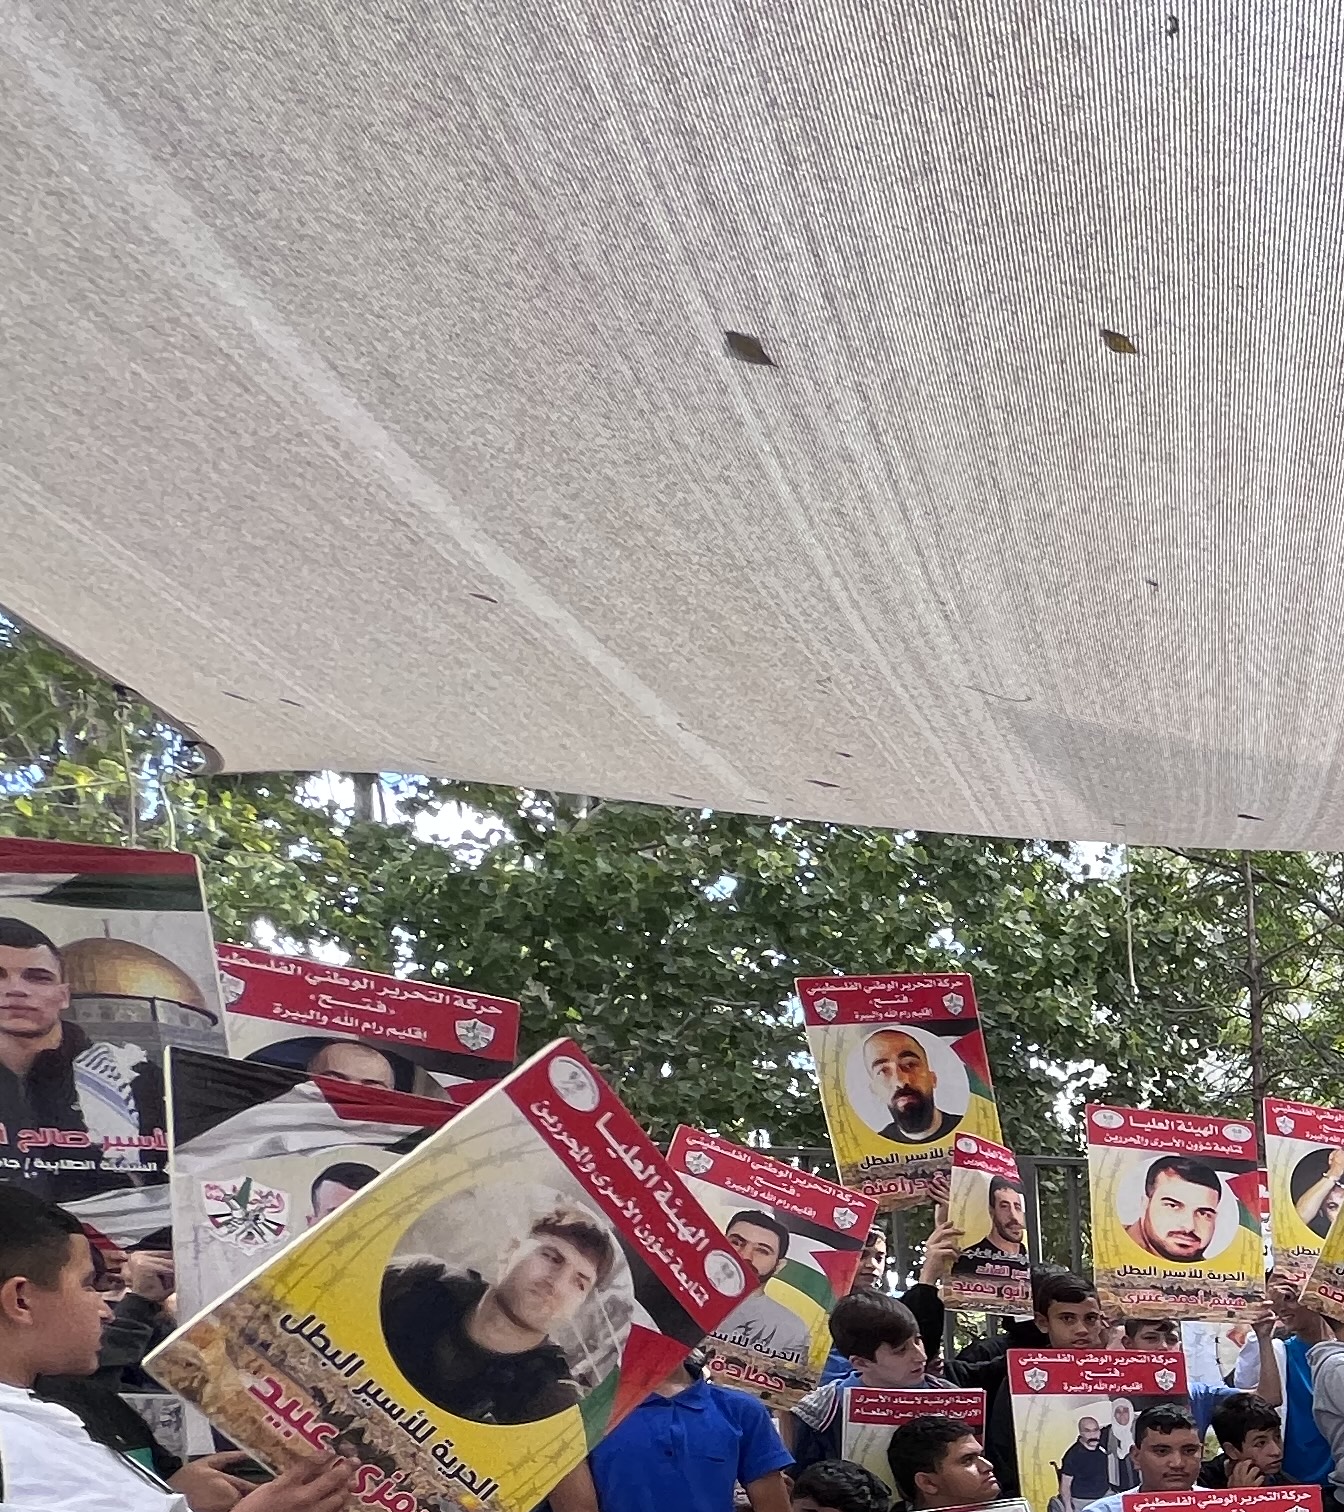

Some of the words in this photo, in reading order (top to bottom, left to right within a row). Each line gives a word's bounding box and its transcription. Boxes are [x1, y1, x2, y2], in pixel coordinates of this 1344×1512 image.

[305, 970, 375, 991] الوطني
[377, 984, 450, 1005] التحرير
[454, 996, 502, 1014] حركة
[1129, 1116, 1174, 1131] العليا
[1176, 1121, 1218, 1135] الهيئة
[595, 1111, 661, 1188] العليا
[653, 1180, 709, 1251] الهيئة
[1117, 1265, 1156, 1277] البطل
[279, 1314, 366, 1378] البطل
[1018, 1354, 1075, 1366] الفلسطيني
[1076, 1355, 1112, 1366] الوطني
[1114, 1355, 1150, 1366] التحرير
[1150, 1354, 1178, 1366] حركة
[709, 1355, 785, 1393] حمادة
[249, 1376, 339, 1451] عبيد
[351, 1378, 437, 1445] للأسير
[431, 1438, 499, 1501] الحرية
[1133, 1496, 1196, 1512] الفلسطيني
[1198, 1495, 1237, 1510] الوطني
[1241, 1493, 1280, 1506] التحرير
[1281, 1491, 1311, 1502] حركة
